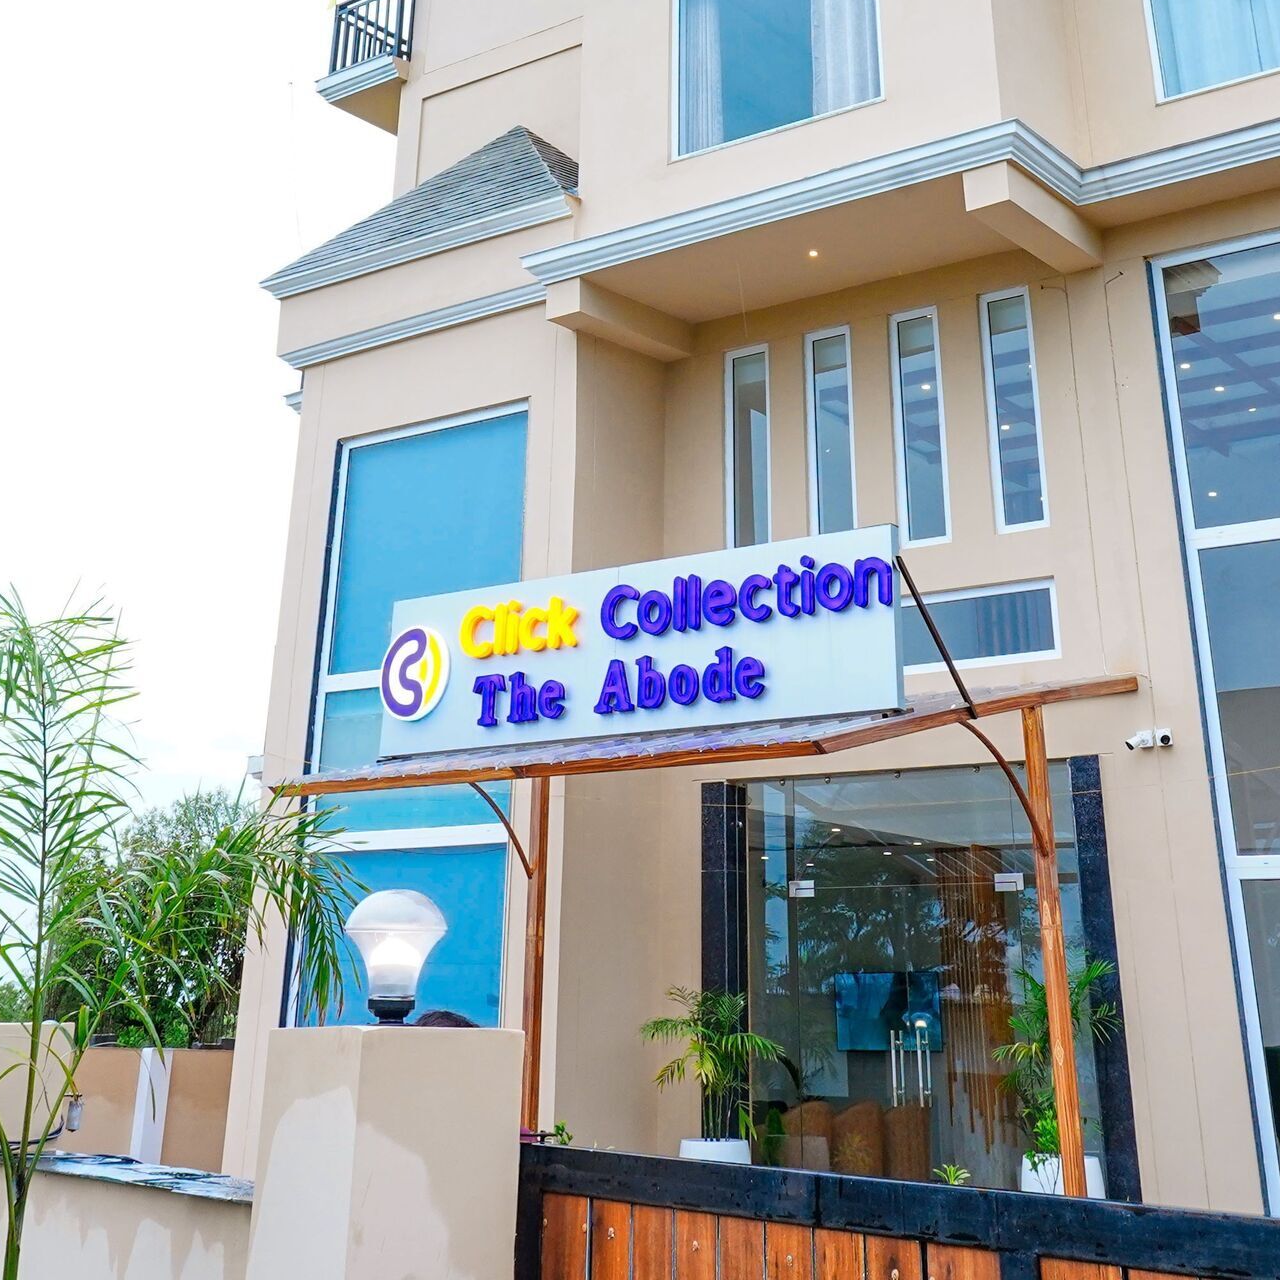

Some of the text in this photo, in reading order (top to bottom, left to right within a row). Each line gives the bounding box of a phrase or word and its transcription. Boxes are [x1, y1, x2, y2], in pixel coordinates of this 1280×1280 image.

[460, 555, 893, 659] Click Collection
[472, 646, 765, 727] The Abode
